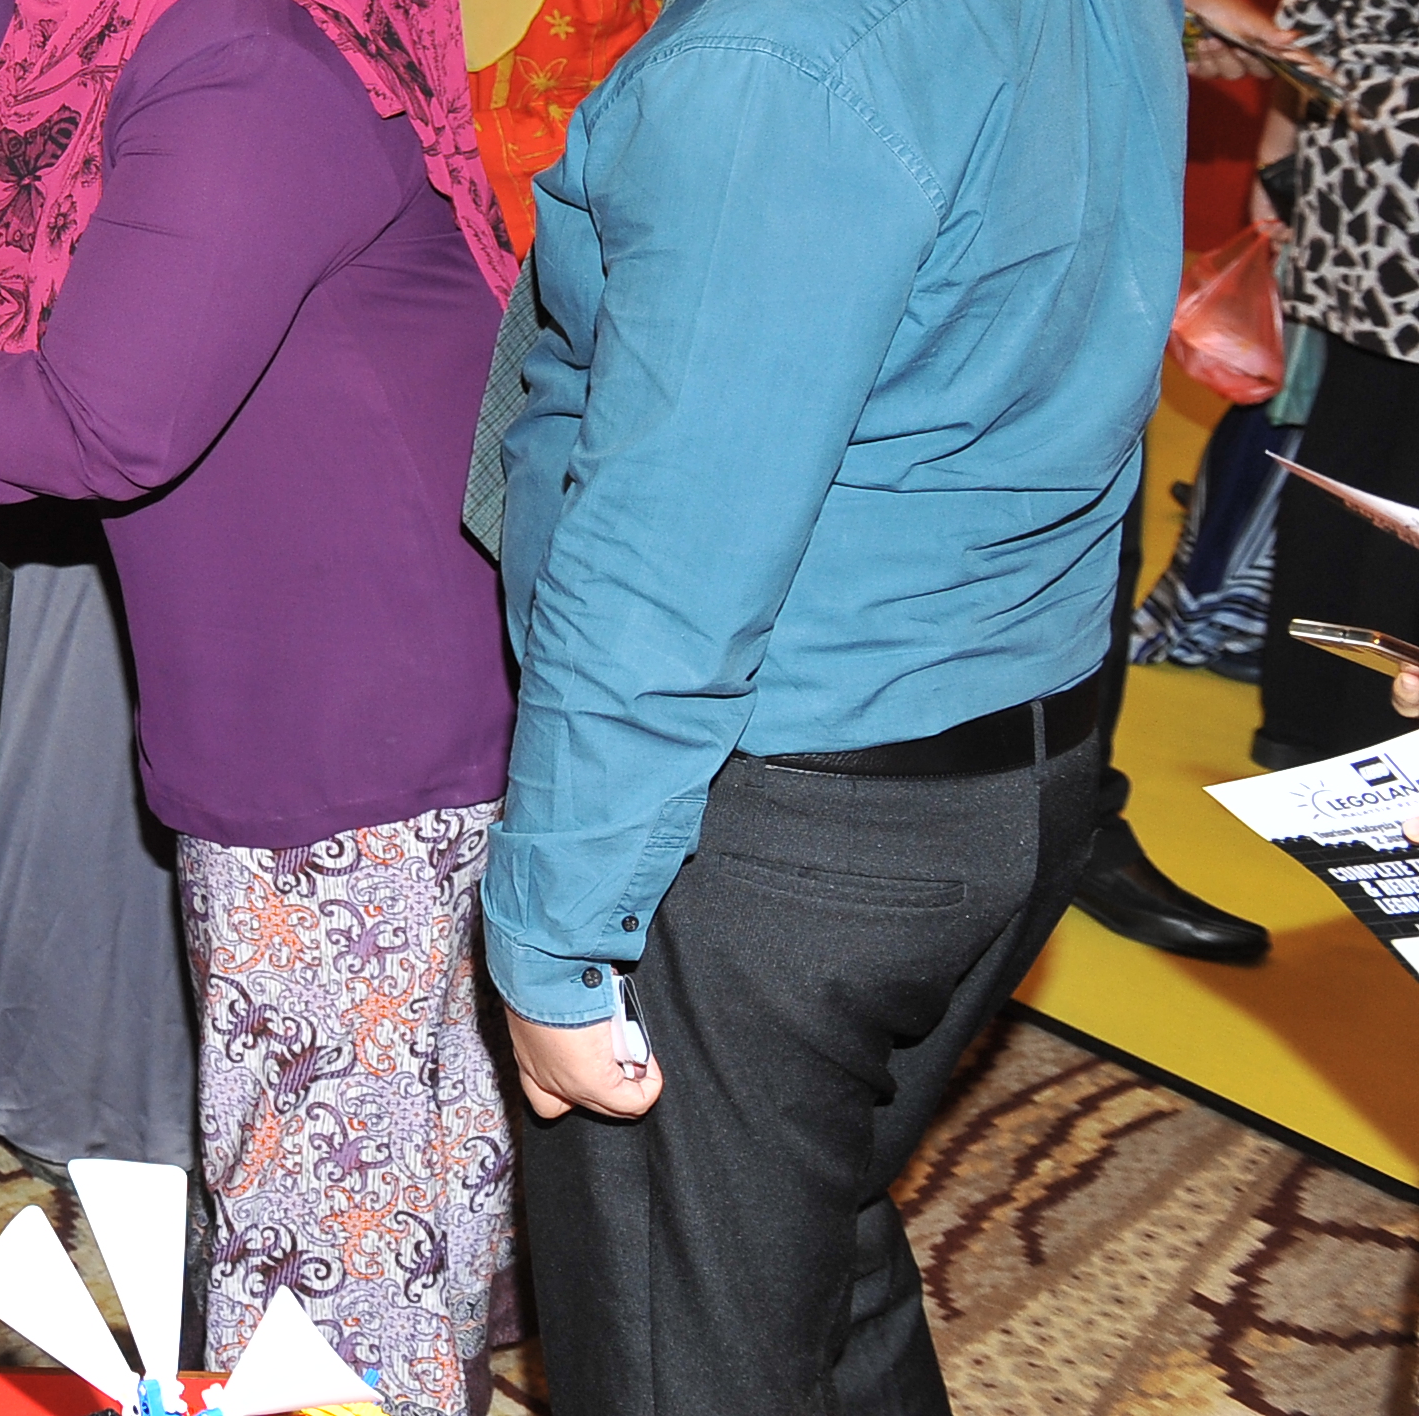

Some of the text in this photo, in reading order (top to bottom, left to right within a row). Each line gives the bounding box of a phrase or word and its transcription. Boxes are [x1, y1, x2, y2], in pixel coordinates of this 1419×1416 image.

[1326, 784, 1419, 811] LEGOLAN
[1327, 860, 1415, 882] COMPLETE
[1358, 880, 1384, 898] &
